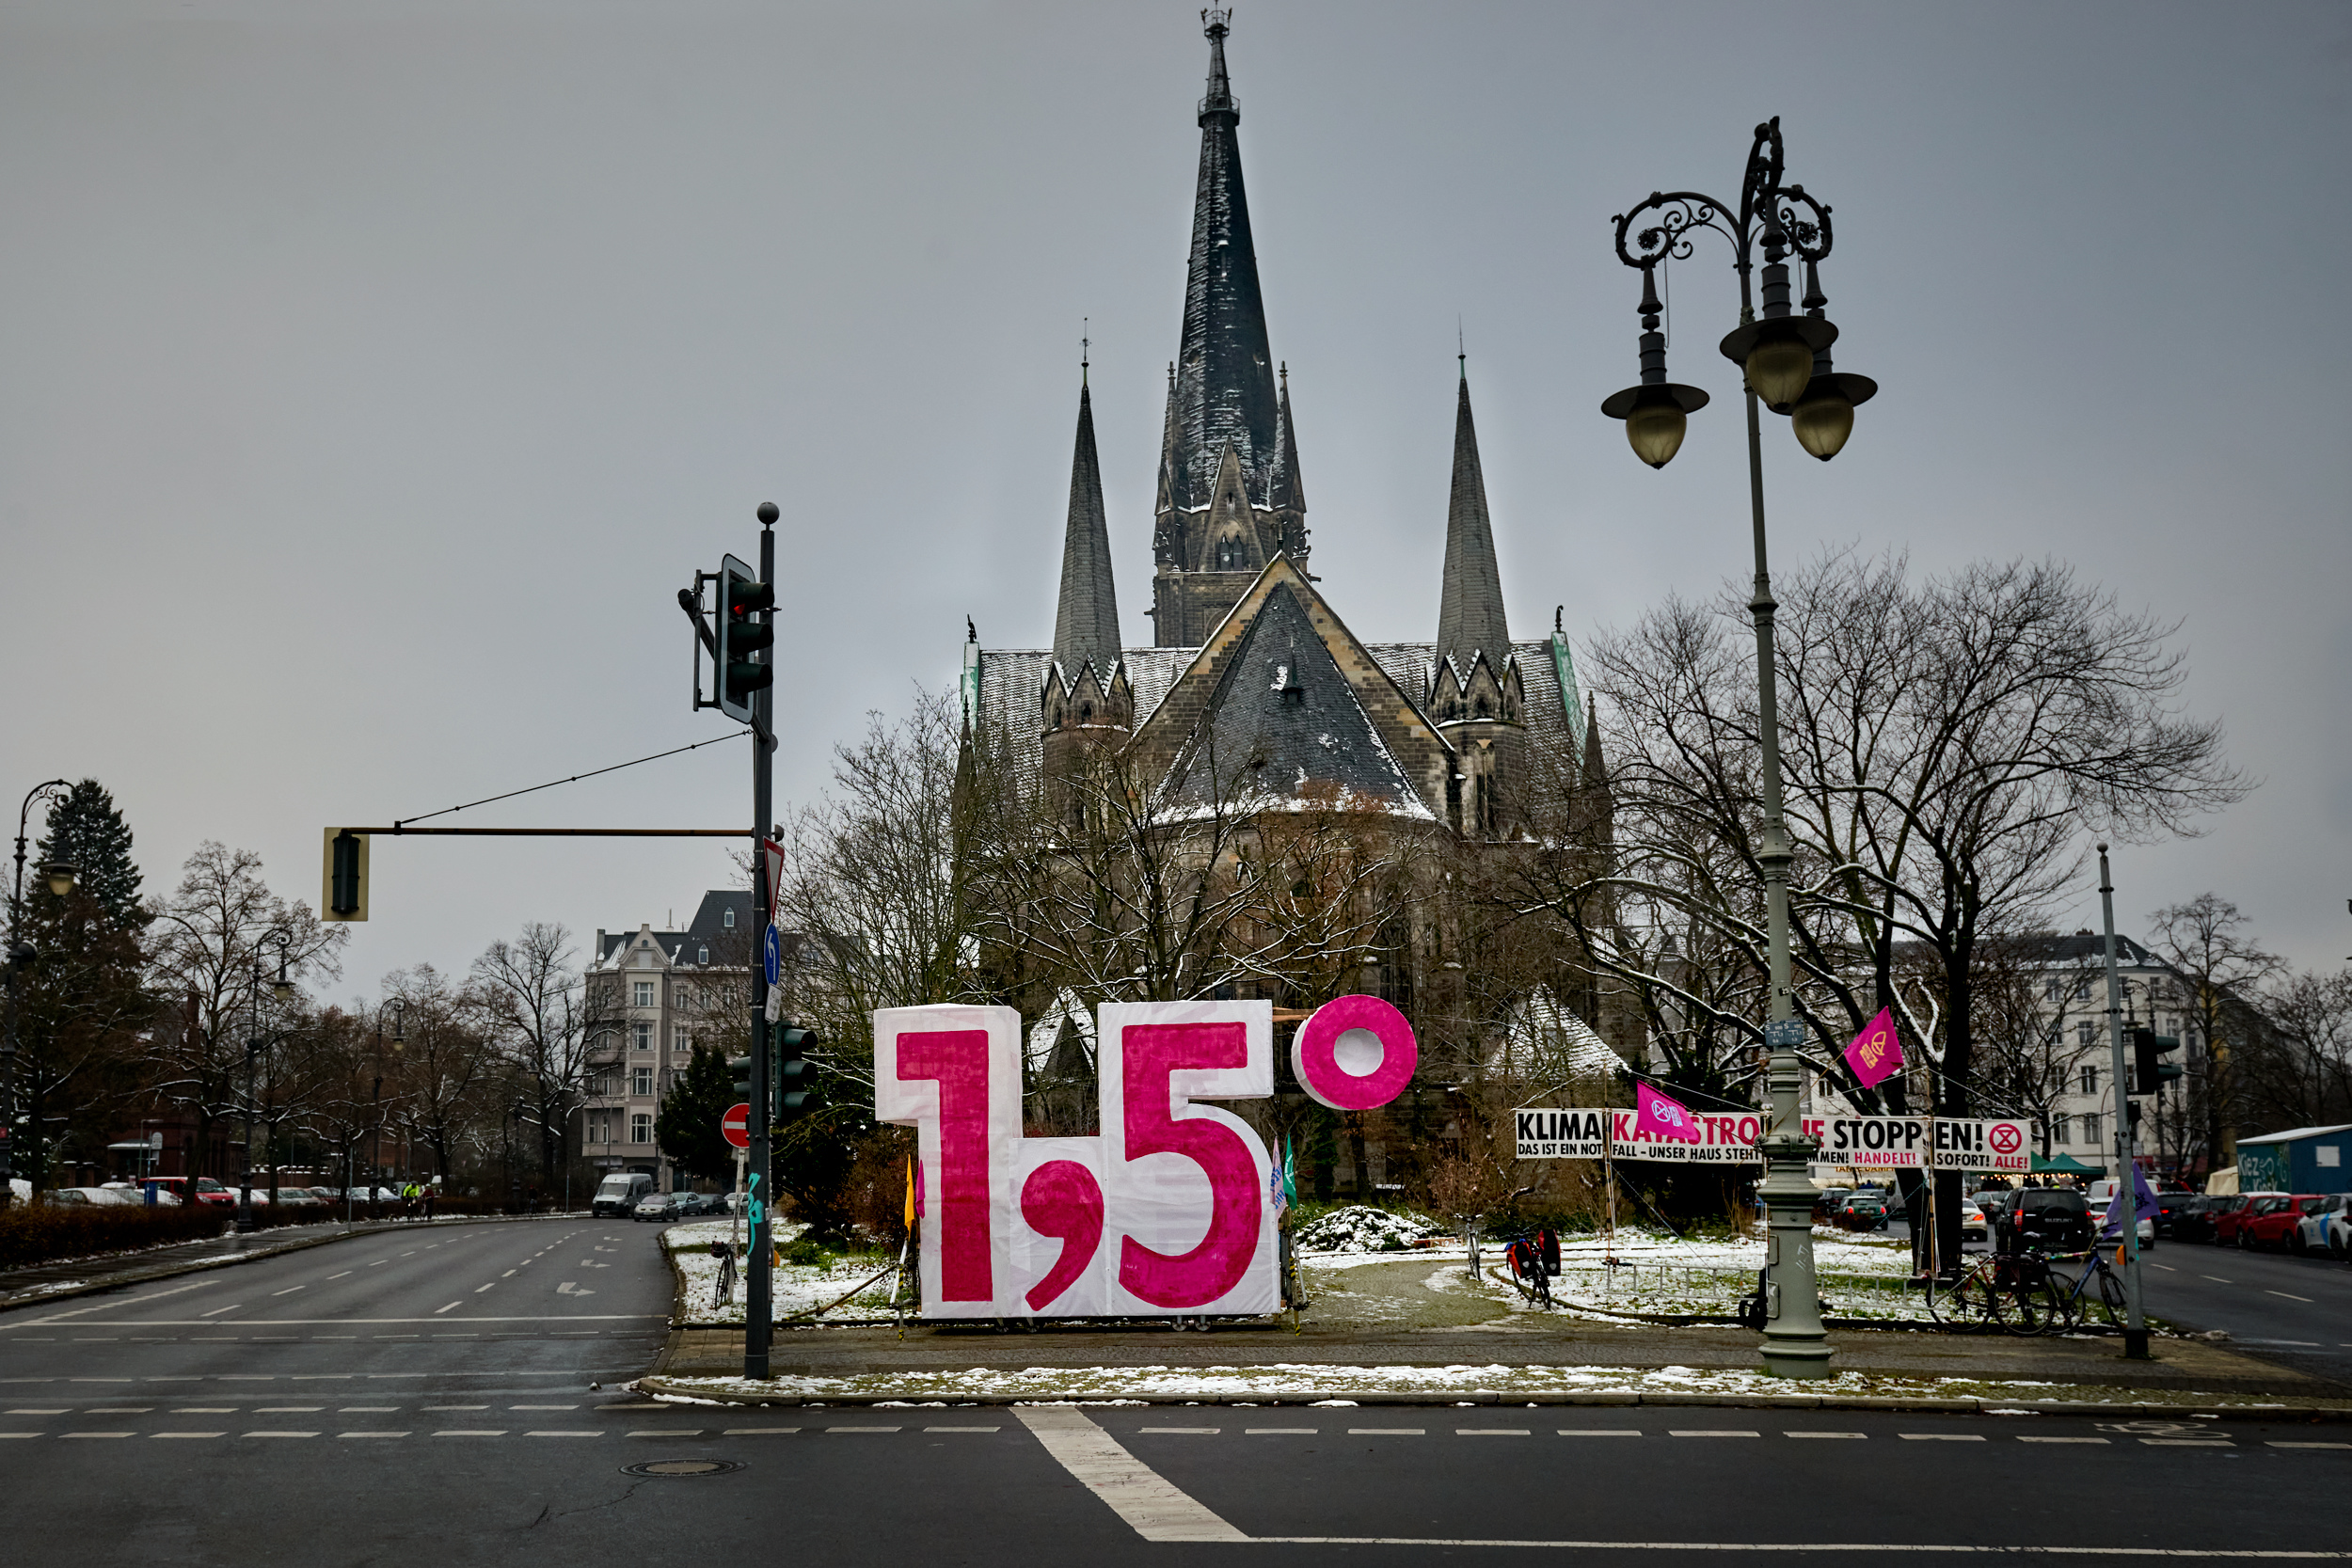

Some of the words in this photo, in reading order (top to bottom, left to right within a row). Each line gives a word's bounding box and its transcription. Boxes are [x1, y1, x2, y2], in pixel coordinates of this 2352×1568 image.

[1518, 1143, 1539, 1155] DAS
[1543, 1143, 1557, 1155] IST
[1561, 1144, 1577, 1155] EIN
[1649, 1147, 1685, 1159] UNSER
[1691, 1148, 1722, 1160] HAUS
[1725, 1148, 1759, 1161] STEHT
[1854, 1152, 1916, 1164] HANDELT!
[1936, 1153, 1990, 1167] SOFORT!
[1994, 1156, 2027, 1169] ALLE!
